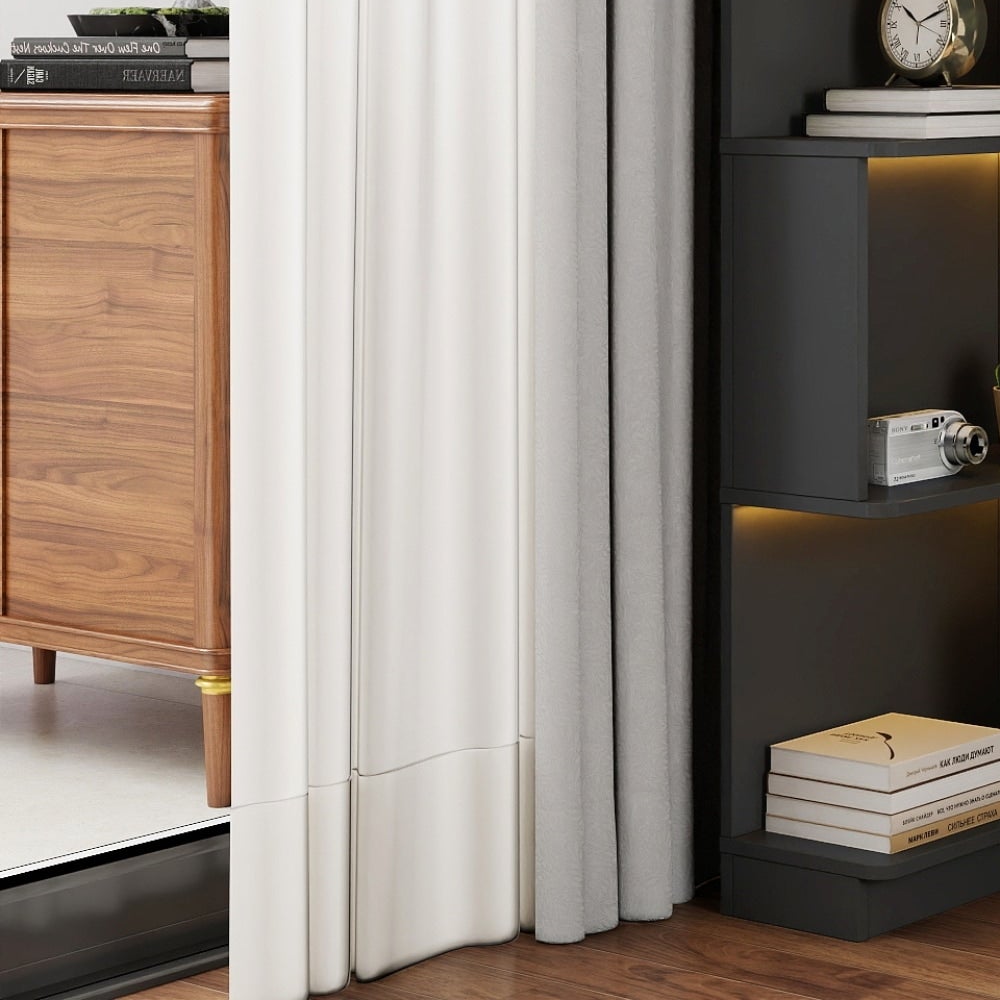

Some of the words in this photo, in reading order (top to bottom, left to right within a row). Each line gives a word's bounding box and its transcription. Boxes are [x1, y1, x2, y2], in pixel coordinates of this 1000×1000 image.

[940, 758, 951, 769] КАК
[952, 753, 970, 765] ЛЮДИ
[970, 745, 995, 760] ДУМАЮТ
[908, 833, 923, 844] МАРК
[948, 816, 975, 832] СИЛЬНЕЕ
[977, 809, 998, 822] СТРАХА
